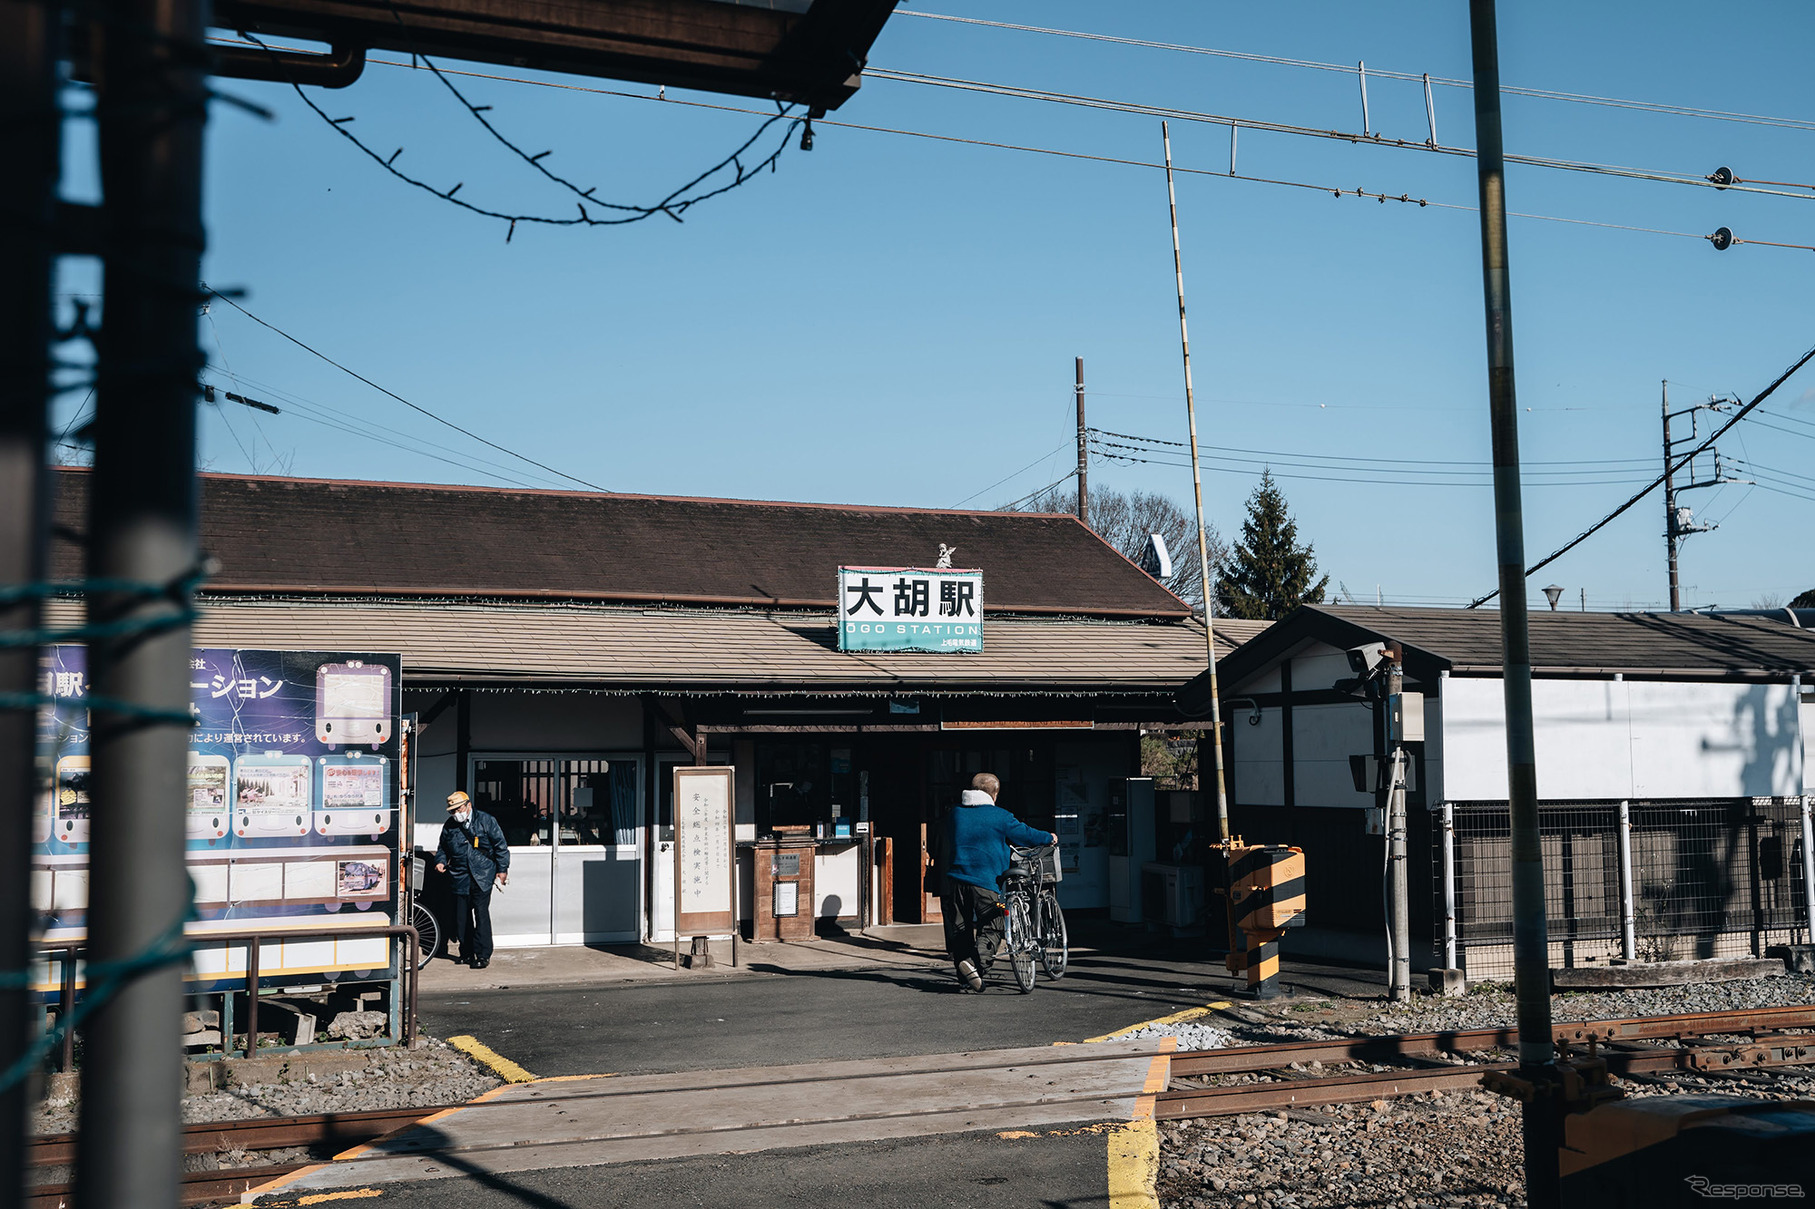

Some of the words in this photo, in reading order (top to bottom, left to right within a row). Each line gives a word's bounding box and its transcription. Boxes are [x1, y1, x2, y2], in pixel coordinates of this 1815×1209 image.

[847, 578, 975, 617] 大胡駅
[897, 624, 978, 635] STATION
[692, 792, 702, 898] 安全総点検実施中
